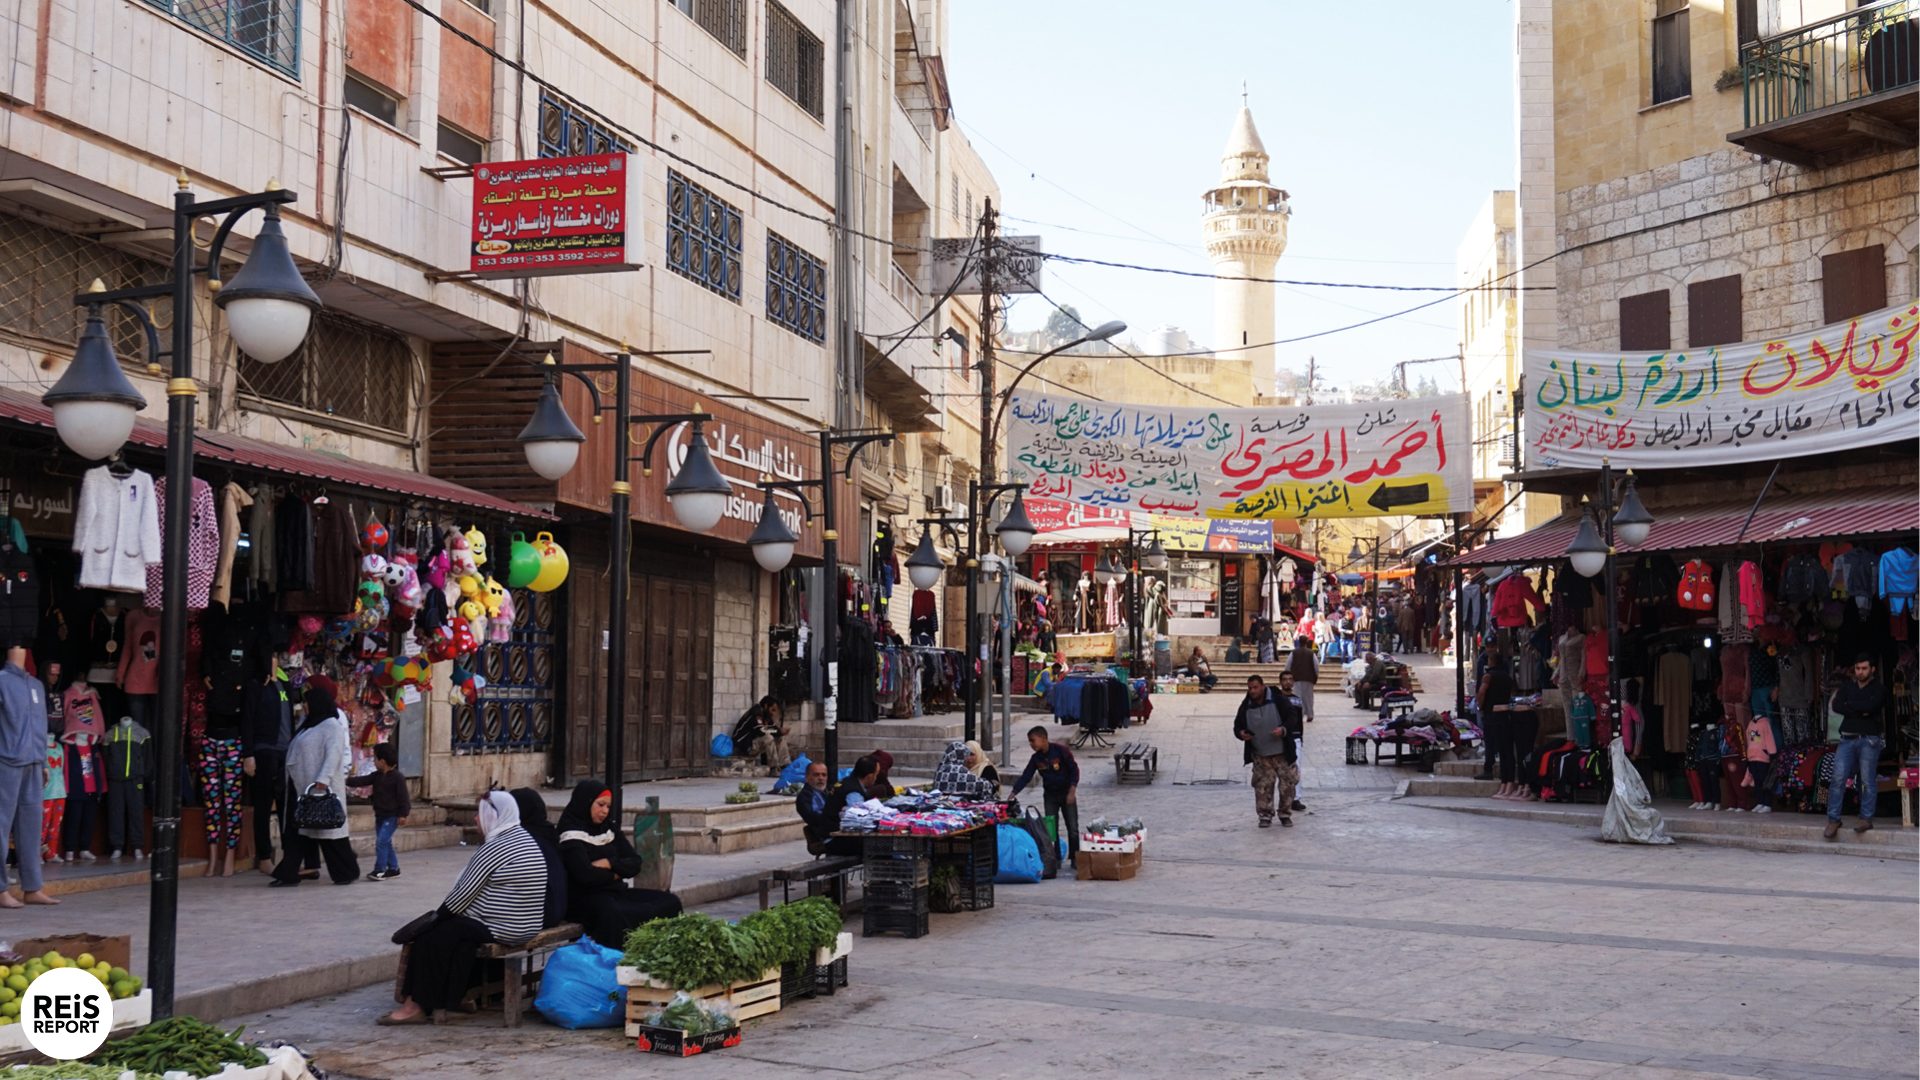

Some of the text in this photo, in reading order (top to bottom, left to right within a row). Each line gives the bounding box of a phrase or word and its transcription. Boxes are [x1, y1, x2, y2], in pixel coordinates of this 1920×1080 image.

[482, 184, 617, 205] محطة معرفة قلعة البلقاء
[478, 204, 620, 239] دورات مختلفة وبأسعار رمزية
[478, 256, 525, 266] 353 3591
[536, 252, 585, 263] 353 3592
[1538, 357, 1624, 416] لبنان
[1134, 410, 1206, 448] تنزيلاتها
[1356, 408, 1397, 436] تعلن
[1763, 404, 1812, 440] مقابل
[1344, 409, 1447, 484] أحمد
[1082, 459, 1127, 484] دينار
[1079, 487, 1132, 506] تغيير
[1138, 494, 1200, 516] بسبب
[1234, 487, 1288, 518] الفرصة
[724, 493, 802, 535] using ank
